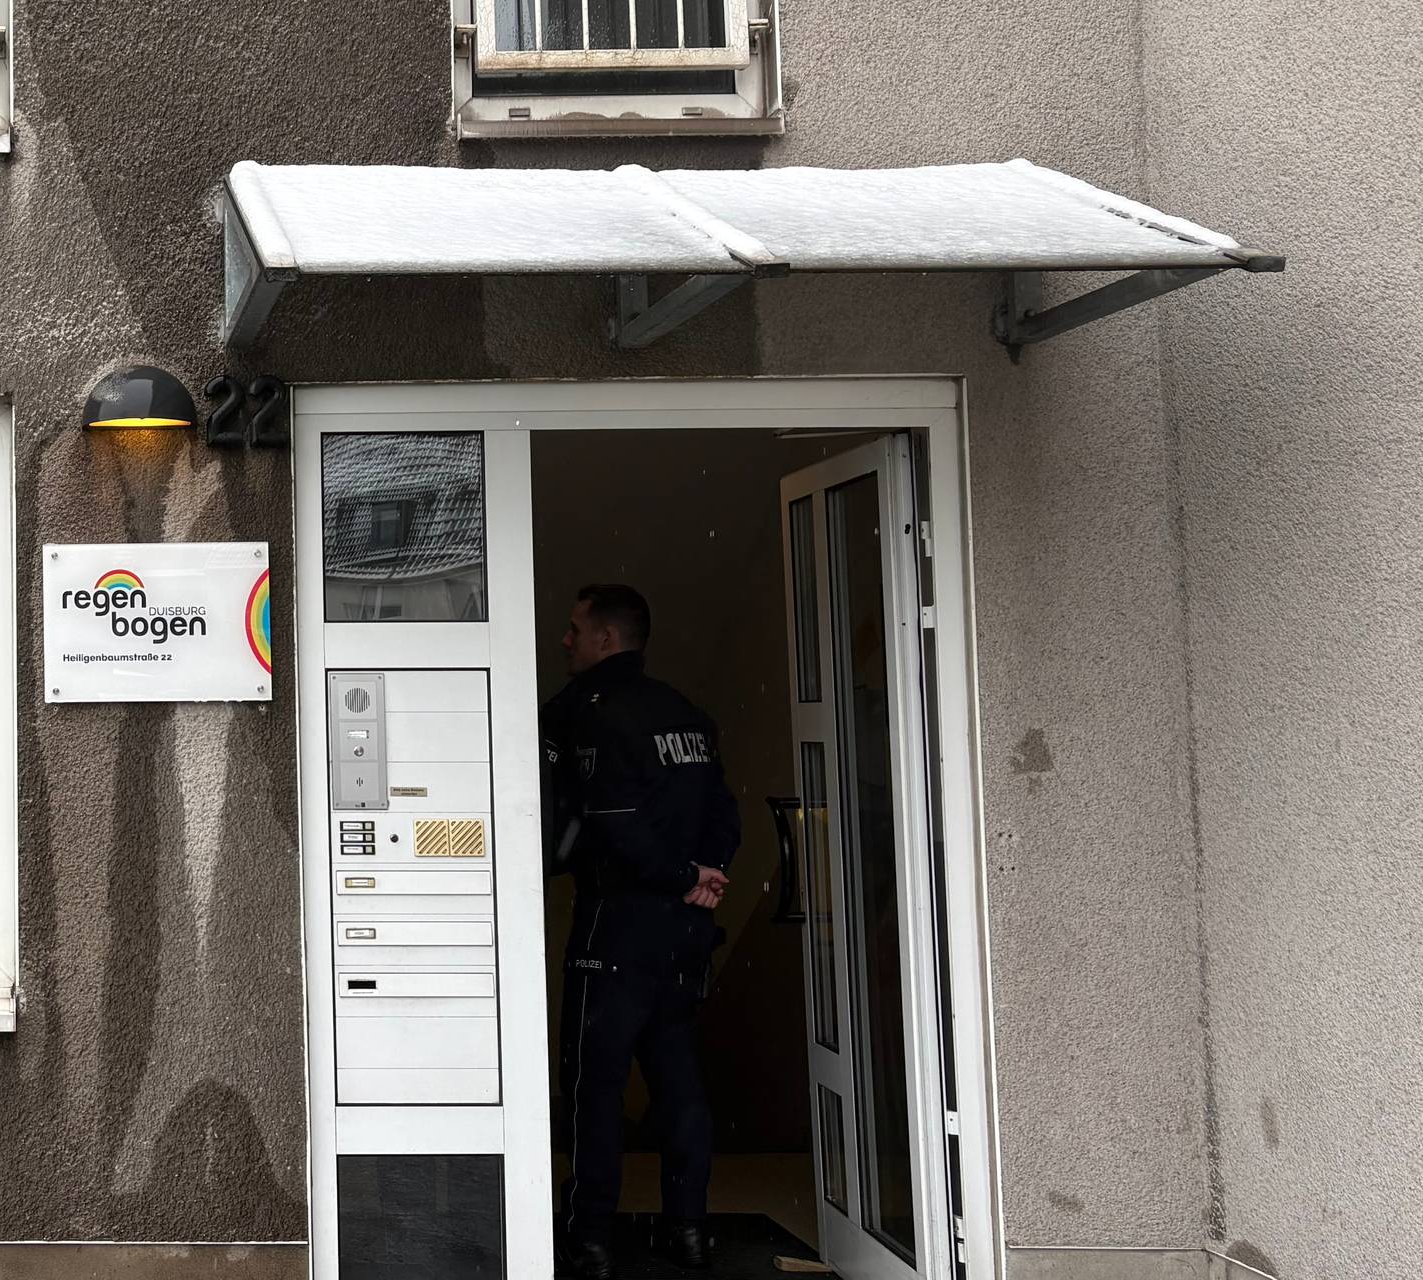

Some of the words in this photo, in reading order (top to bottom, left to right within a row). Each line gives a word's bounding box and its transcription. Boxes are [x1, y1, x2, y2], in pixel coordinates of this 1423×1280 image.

[205, 375, 288, 446] 22
[62, 590, 147, 616] regen
[148, 607, 207, 616] DUISBURG
[111, 612, 207, 644] bogen
[63, 653, 159, 664] Heiligenbaumstraße
[653, 732, 711, 766] POLIZE
[575, 959, 602, 969] POLIZEI
